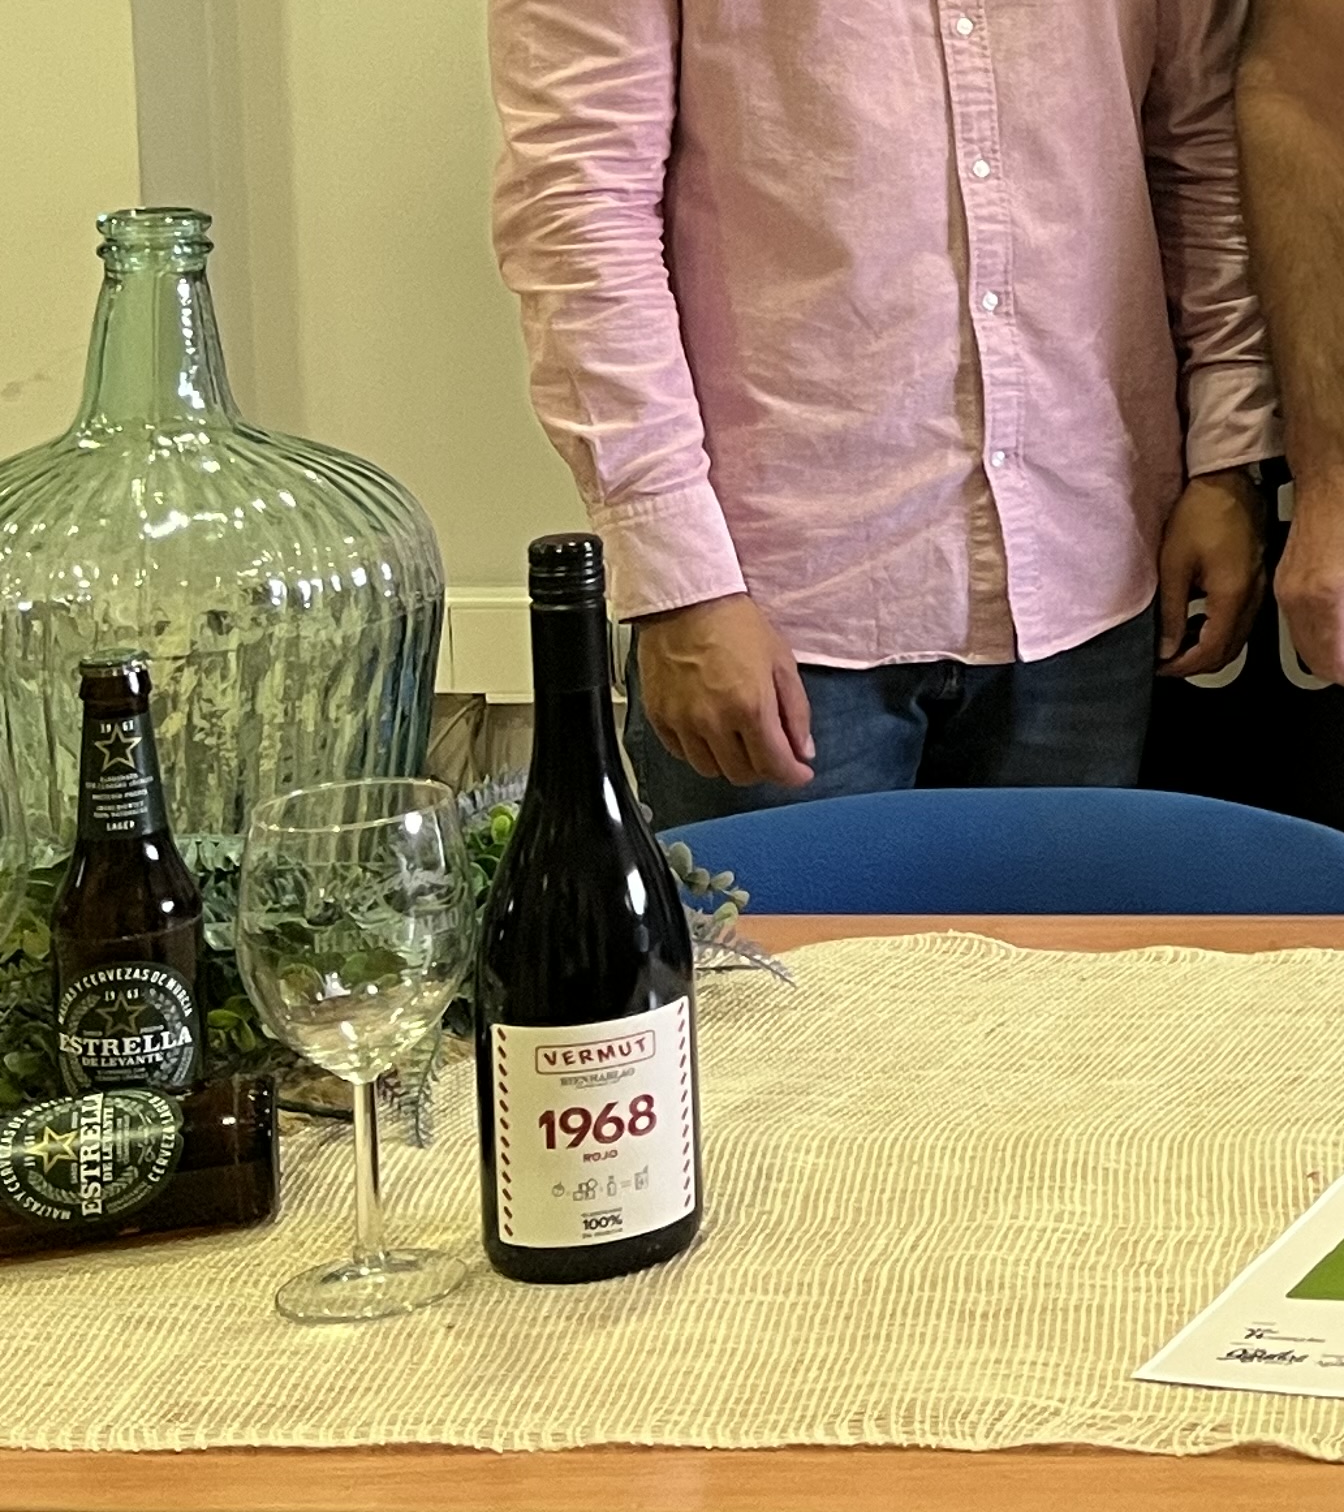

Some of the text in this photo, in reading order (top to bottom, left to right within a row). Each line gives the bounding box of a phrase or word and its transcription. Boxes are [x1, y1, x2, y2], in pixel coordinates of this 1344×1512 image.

[82, 967, 150, 989] CERVEZAS
[58, 1026, 193, 1057] ESTRELLA
[544, 1037, 646, 1066] VERMUT
[538, 1094, 657, 1150] 1968
[80, 1092, 104, 1216] ESTRELLA
[147, 1124, 175, 1183] CERVEZA
[583, 1149, 618, 1163] ROJO
[582, 1214, 623, 1231] 100%
